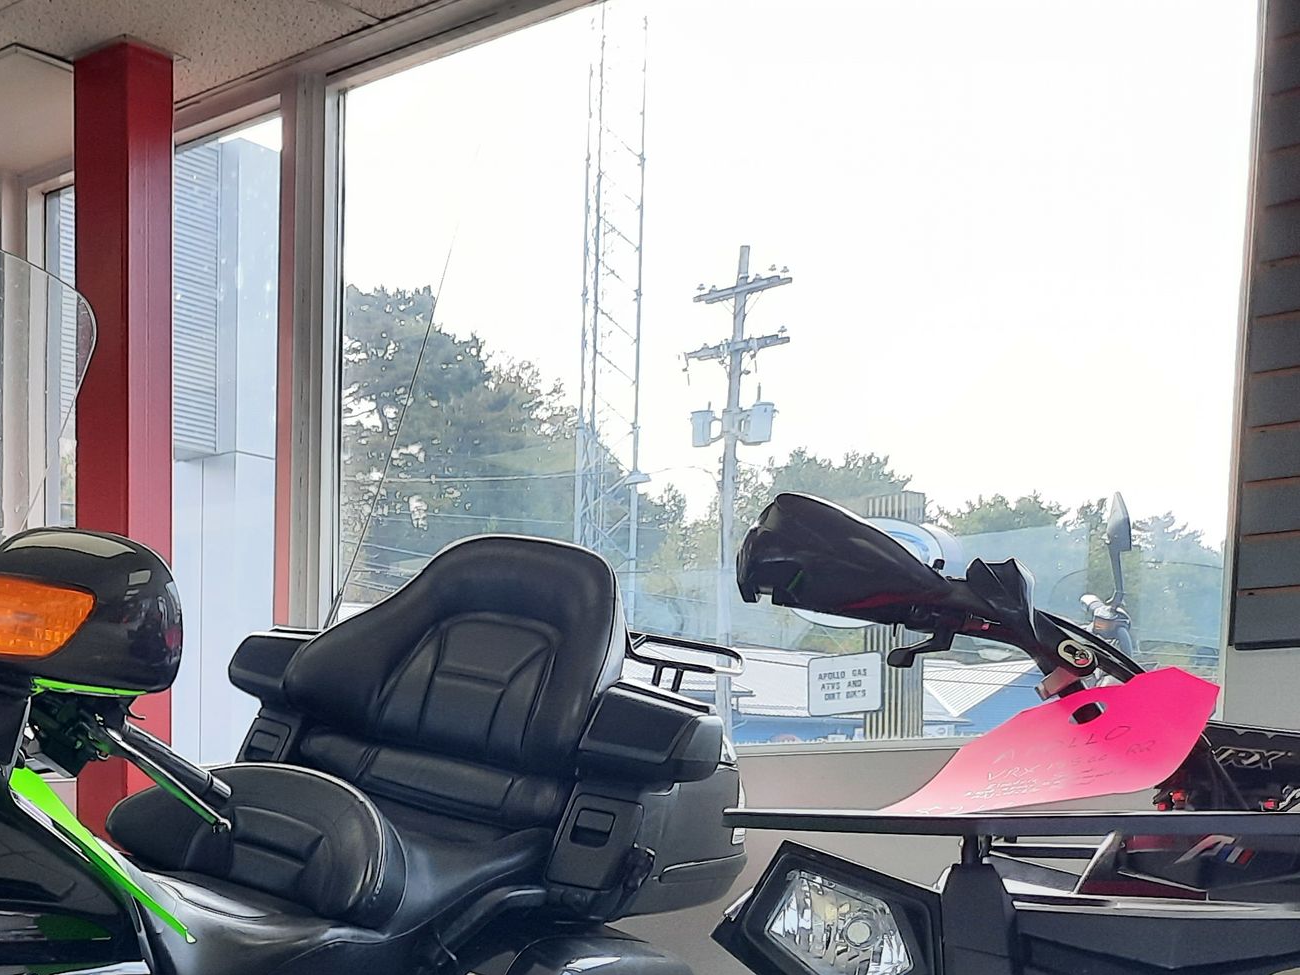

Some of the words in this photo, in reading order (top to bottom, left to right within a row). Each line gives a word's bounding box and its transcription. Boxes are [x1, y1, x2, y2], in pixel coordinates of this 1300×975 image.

[818, 671, 846, 680] APOLLO
[851, 668, 867, 677] GAS
[821, 682, 841, 691] ATVS
[847, 680, 862, 688] AND
[989, 725, 1131, 765] ALLO
